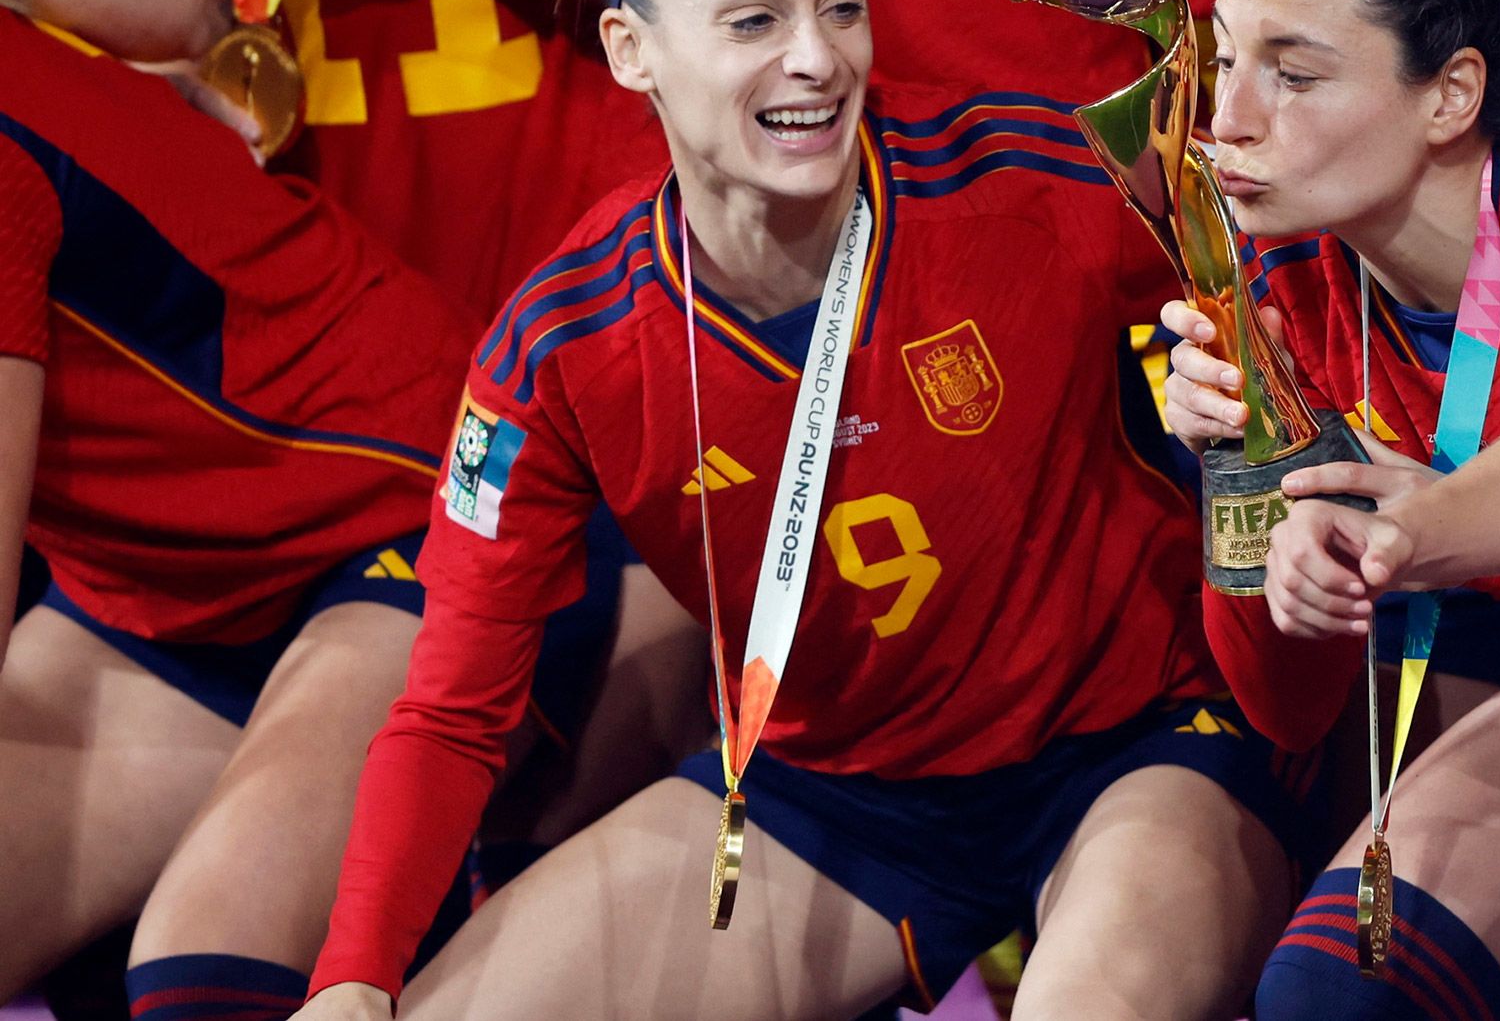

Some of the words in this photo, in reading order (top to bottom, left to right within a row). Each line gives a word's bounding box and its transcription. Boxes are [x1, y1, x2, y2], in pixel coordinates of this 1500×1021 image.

[830, 215, 861, 317] WOMEN'S
[814, 318, 842, 394] WORLD
[805, 395, 826, 441] CUP
[1215, 498, 1289, 534] FIFA
[823, 493, 942, 638] 9
